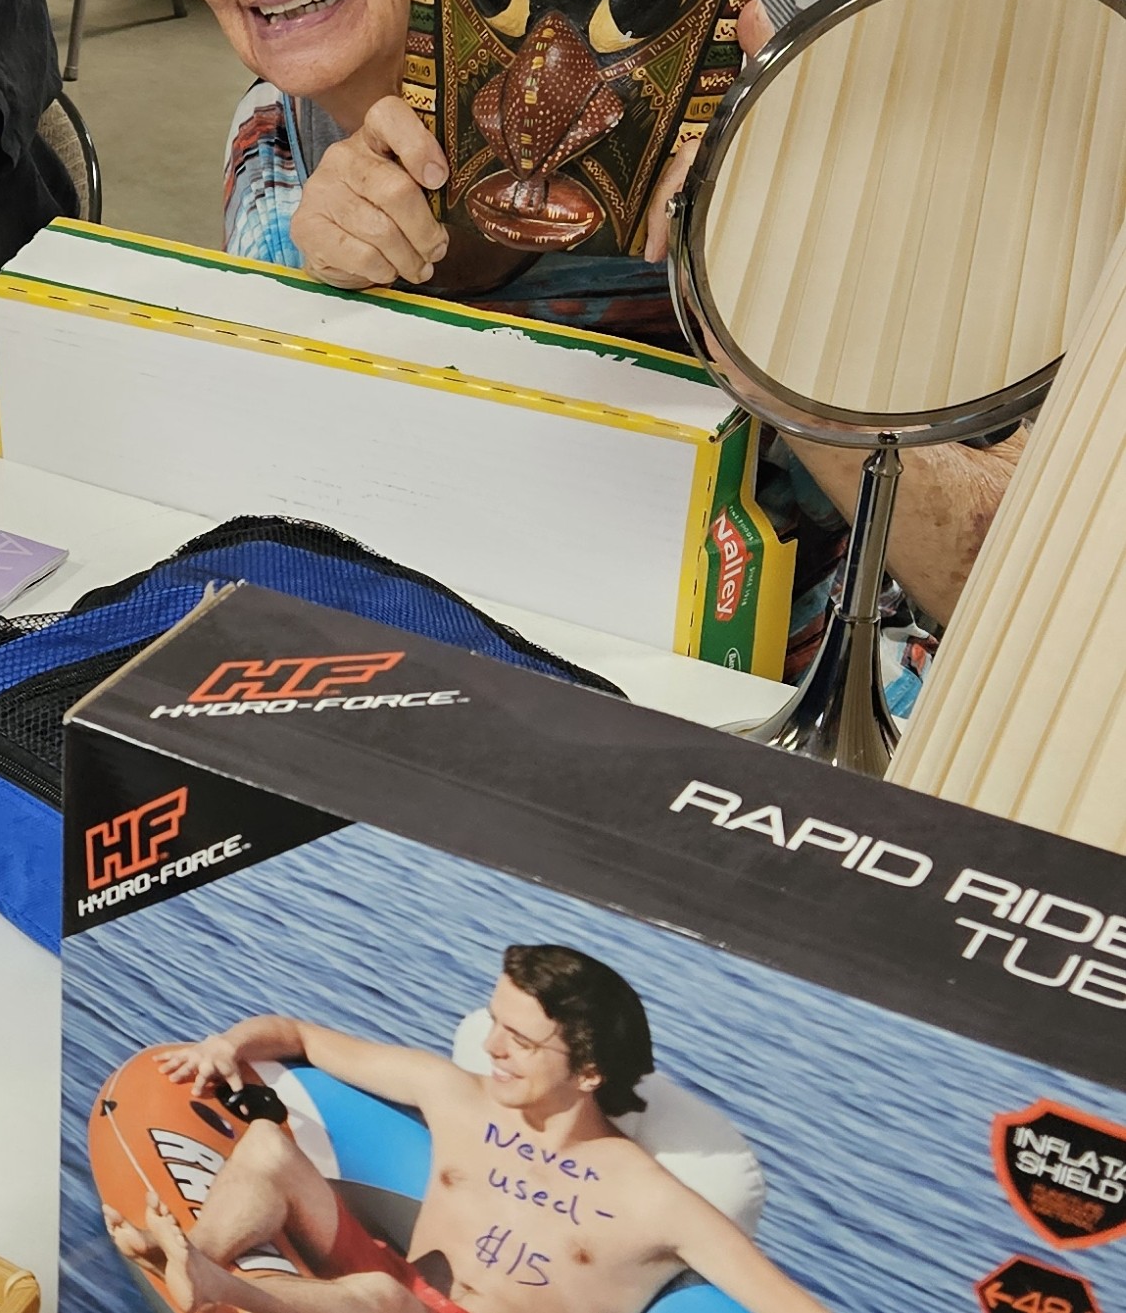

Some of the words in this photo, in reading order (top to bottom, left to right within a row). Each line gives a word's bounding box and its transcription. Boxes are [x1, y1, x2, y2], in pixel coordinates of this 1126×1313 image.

[715, 513, 744, 615] Nalley
[150, 690, 461, 719] HYDRO-FORCE
[187, 651, 406, 702] HF
[85, 786, 189, 891] HF
[669, 780, 934, 887] RAPID
[78, 834, 244, 917] HYDRO-FORCE
[485, 1123, 600, 1183] Never
[1015, 1150, 1125, 1204] SHIELD
[475, 1225, 551, 1287] $15
